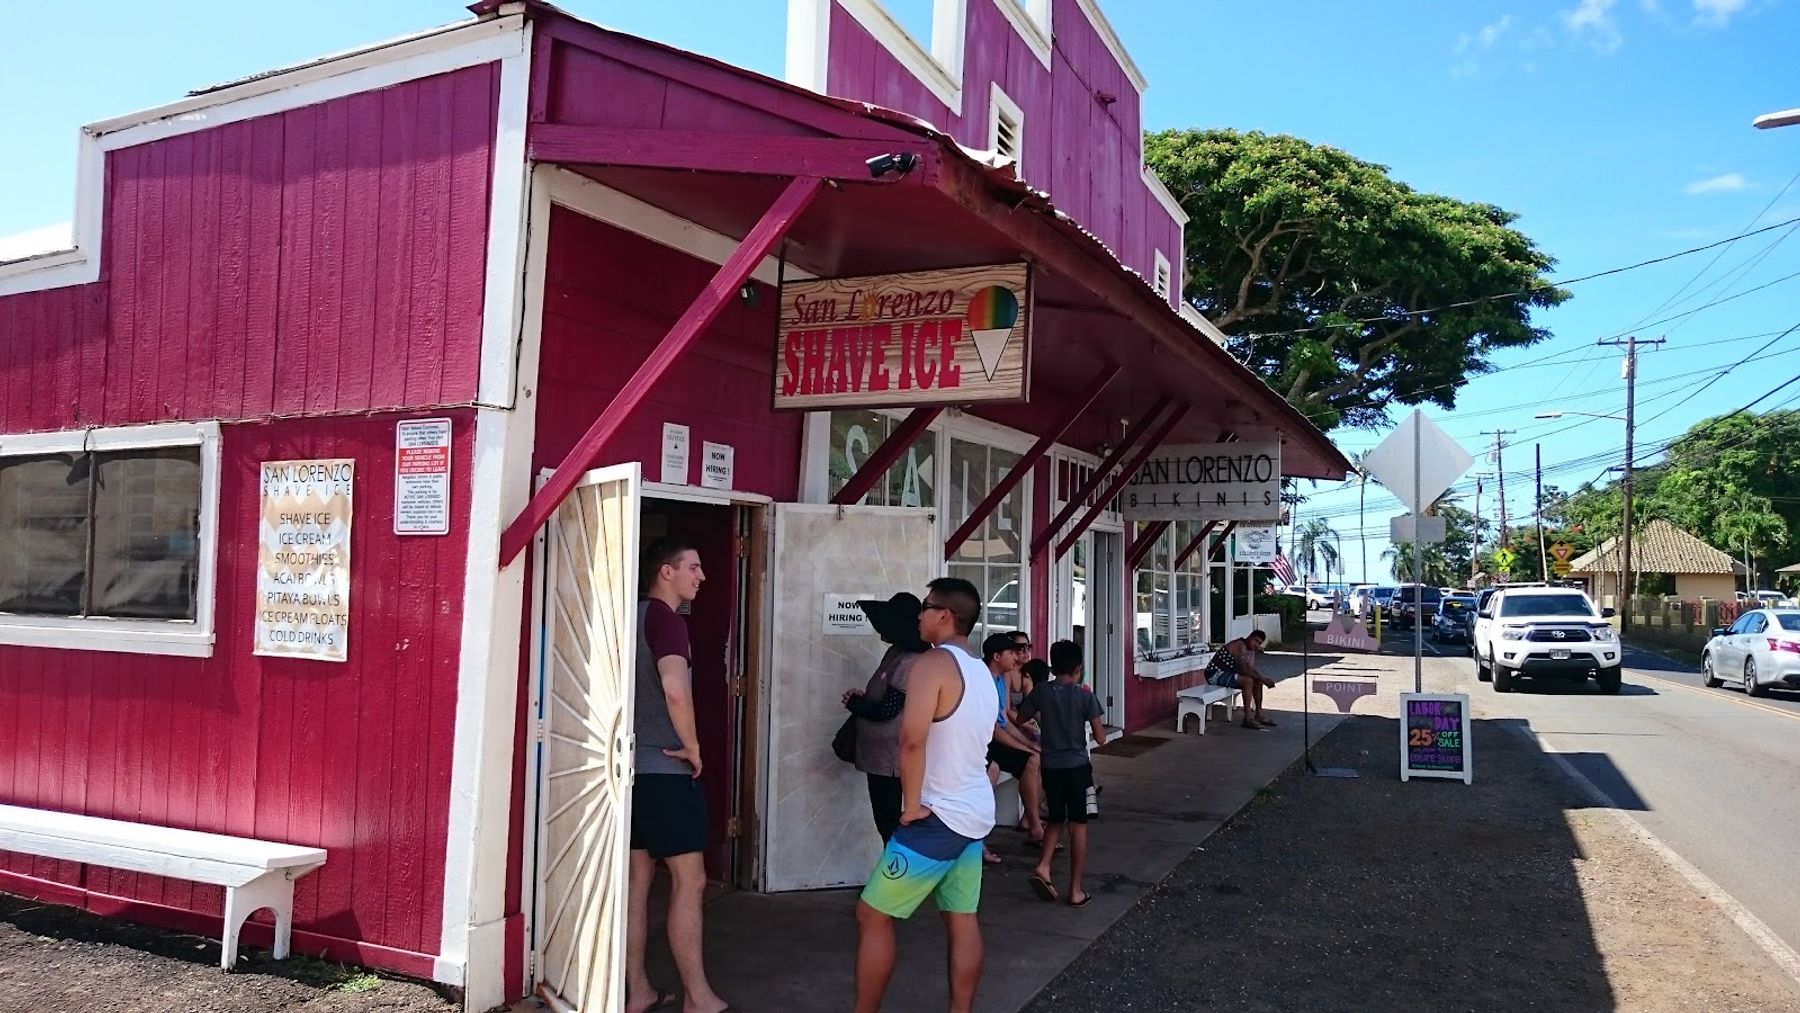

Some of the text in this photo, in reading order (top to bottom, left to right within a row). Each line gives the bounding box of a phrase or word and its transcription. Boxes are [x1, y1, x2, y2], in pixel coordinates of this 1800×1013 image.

[792, 294, 837, 324] San
[783, 319, 962, 396] SHAVE ICE
[711, 452, 726, 461] NOW
[264, 464, 352, 484] SAN LORENZO
[1177, 454, 1272, 484] LORENZO
[264, 484, 351, 497] SHAVE ICE
[1130, 491, 1271, 508] BIKINIS
[280, 513, 331, 525] SHAVE ICE
[279, 533, 331, 545] ICE CREAM
[274, 553, 335, 566] SMOOTHIES
[267, 592, 301, 605] PITAYA
[275, 611, 308, 624] CREAM
[310, 613, 347, 626] FLOATS
[828, 614, 863, 622] HIRING
[269, 630, 334, 645] COLD DRINKS
[1327, 634, 1365, 648] BIKINI
[1326, 682, 1363, 693] POINT
[1409, 702, 1441, 716] LABOR
[1435, 716, 1460, 730] DAY
[1438, 739, 1461, 748] SALE
